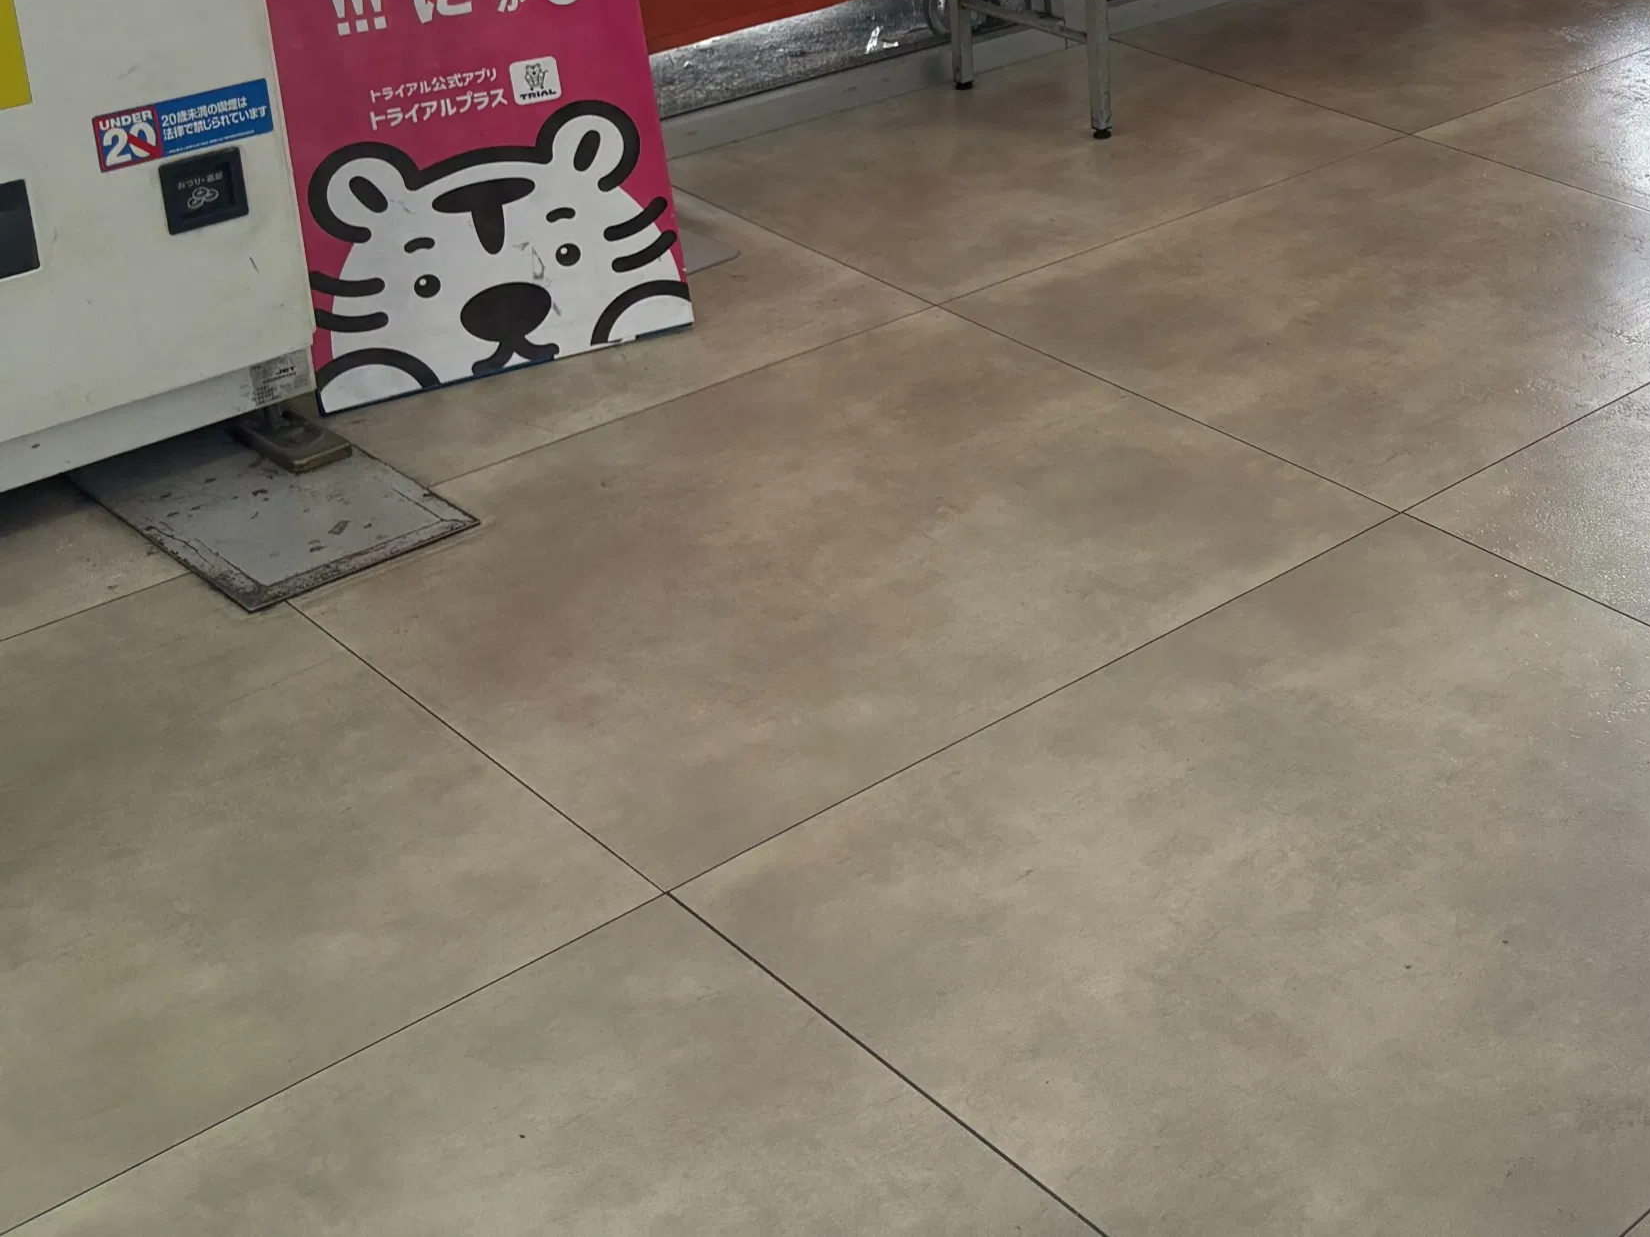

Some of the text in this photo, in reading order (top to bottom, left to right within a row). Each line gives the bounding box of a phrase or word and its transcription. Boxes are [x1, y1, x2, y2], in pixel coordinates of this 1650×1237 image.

[369, 67, 498, 103] トライアル公式アプリ
[98, 110, 154, 131] UNDER
[161, 95, 248, 127] 20歳未満の喫煙は
[163, 105, 268, 141] 法律で禁じられています
[369, 88, 509, 131] トライアルプラス
[103, 121, 157, 167] 20
